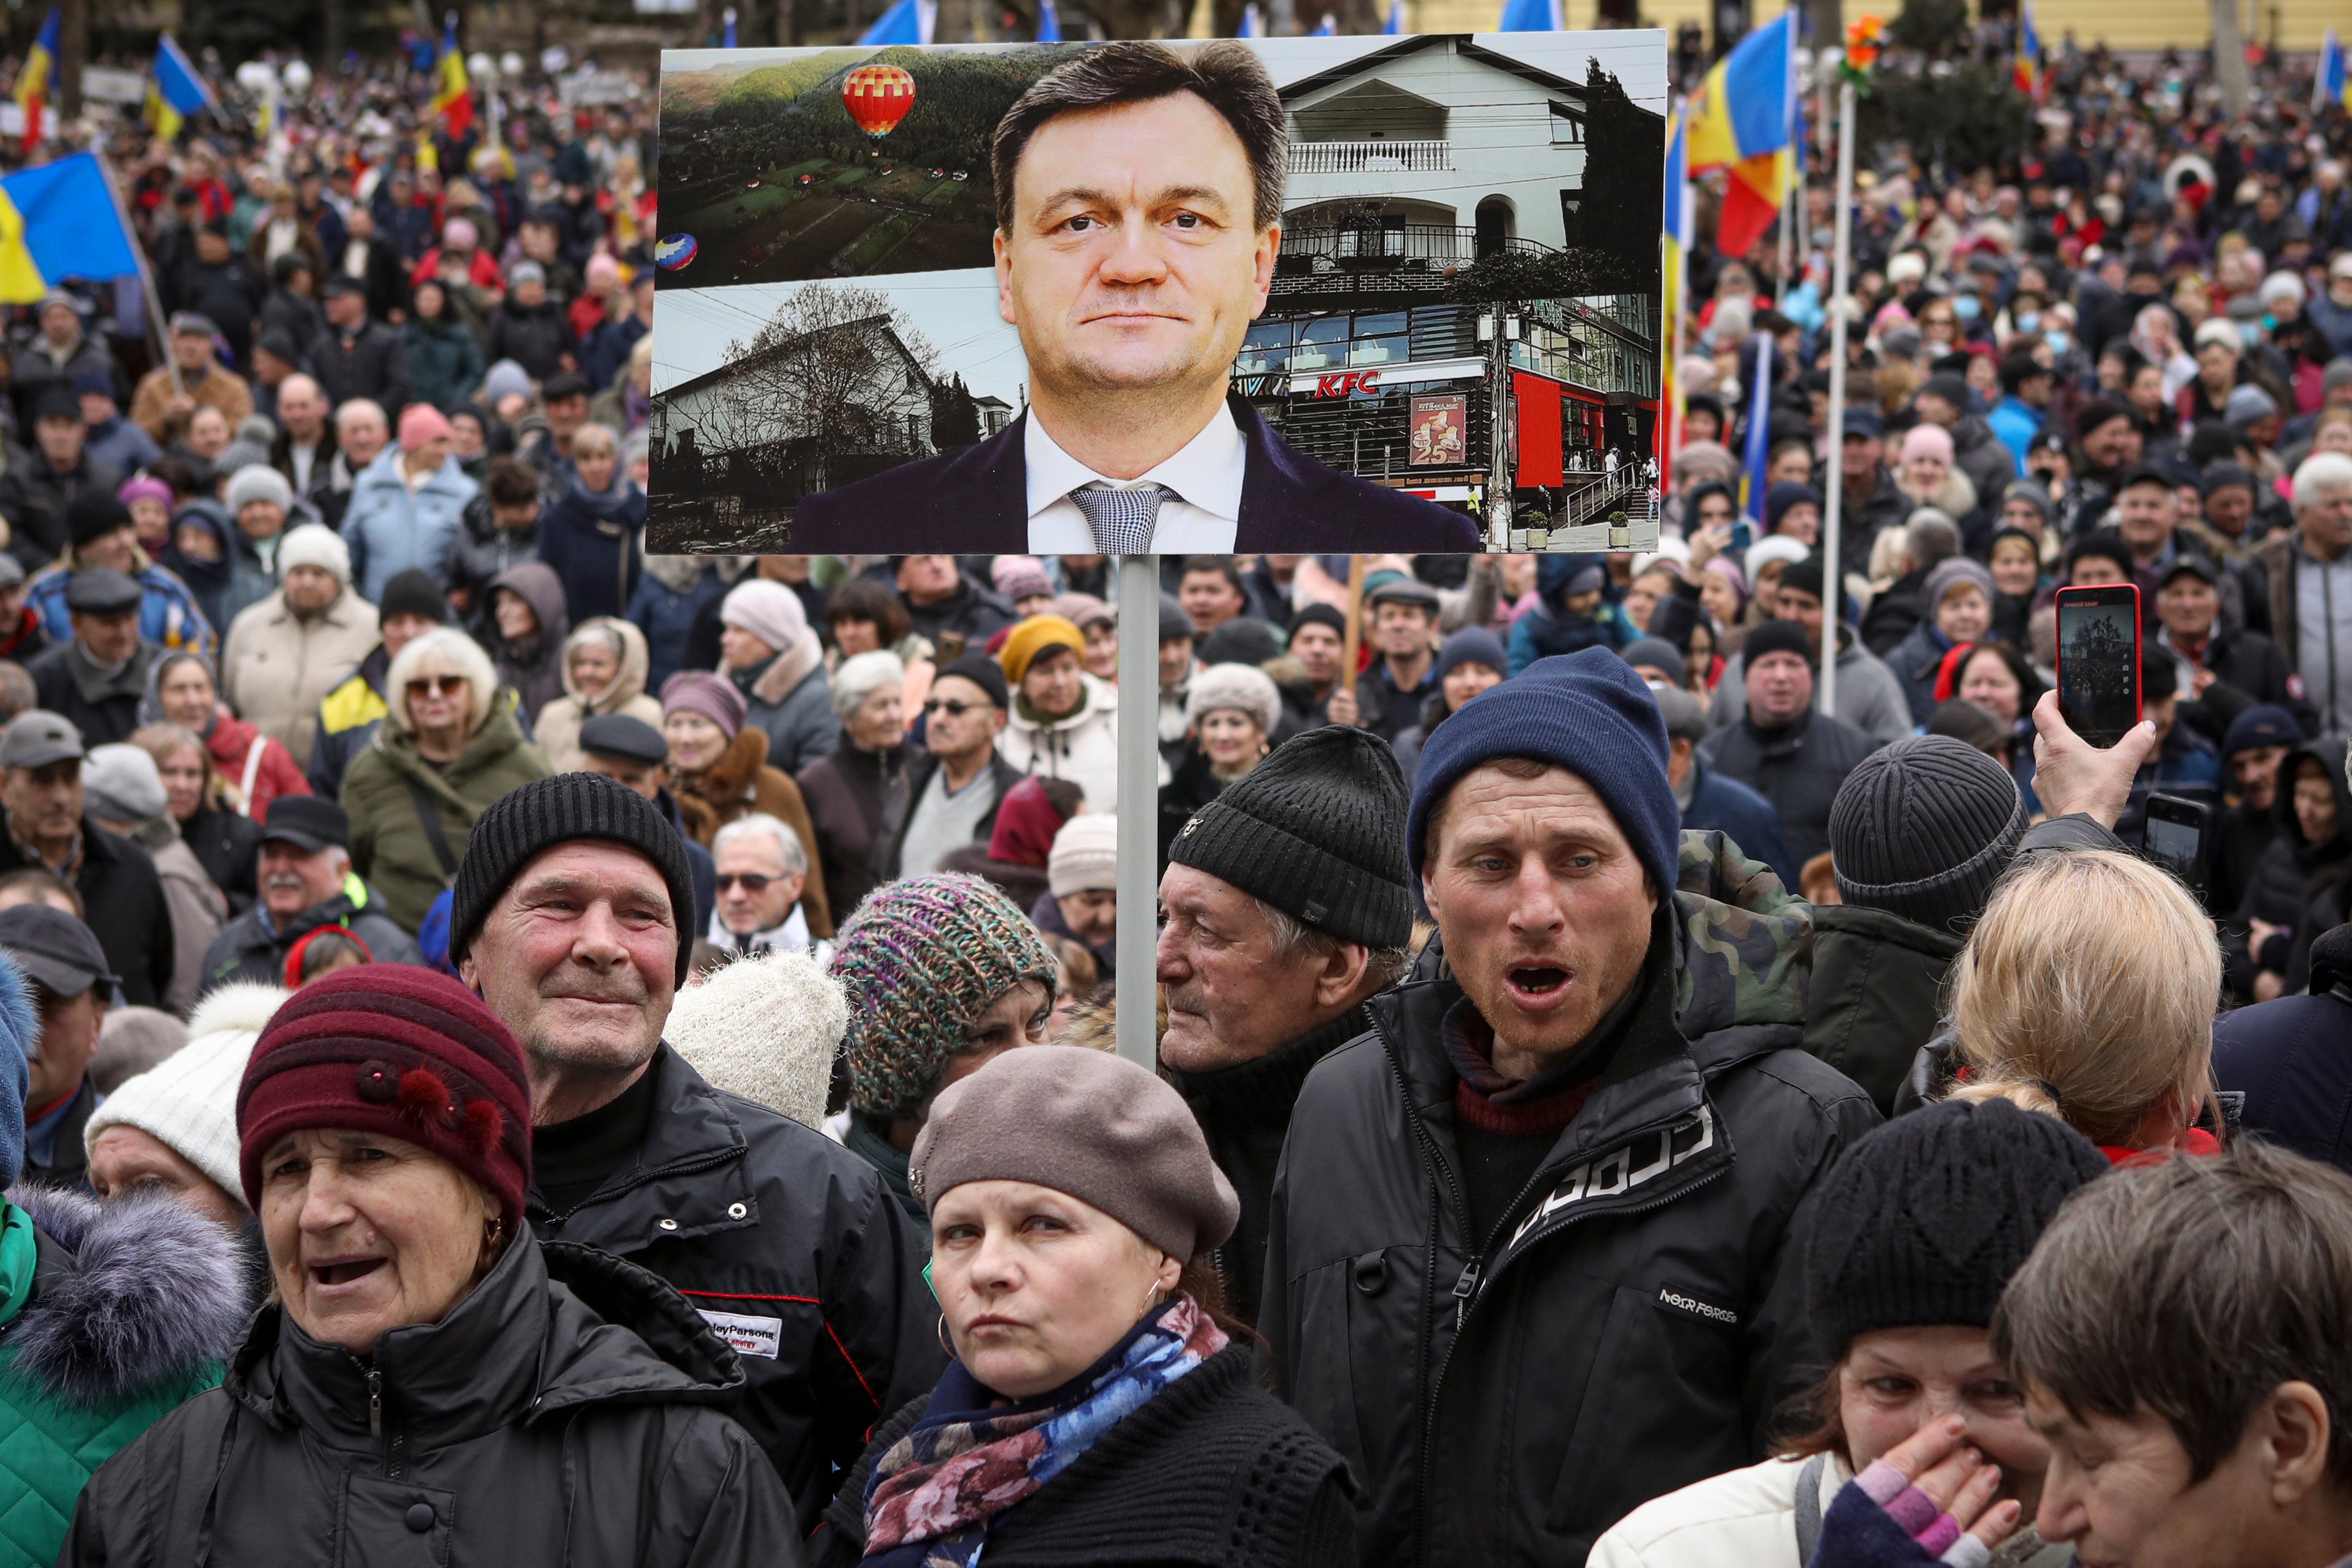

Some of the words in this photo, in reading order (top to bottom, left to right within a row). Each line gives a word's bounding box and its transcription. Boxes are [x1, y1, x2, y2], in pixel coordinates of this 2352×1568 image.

[1312, 371, 1378, 398] KFC
[1414, 445, 1447, 463] 25
[1660, 1289, 1696, 1312] NOIR
[731, 1339, 756, 1349] energy
